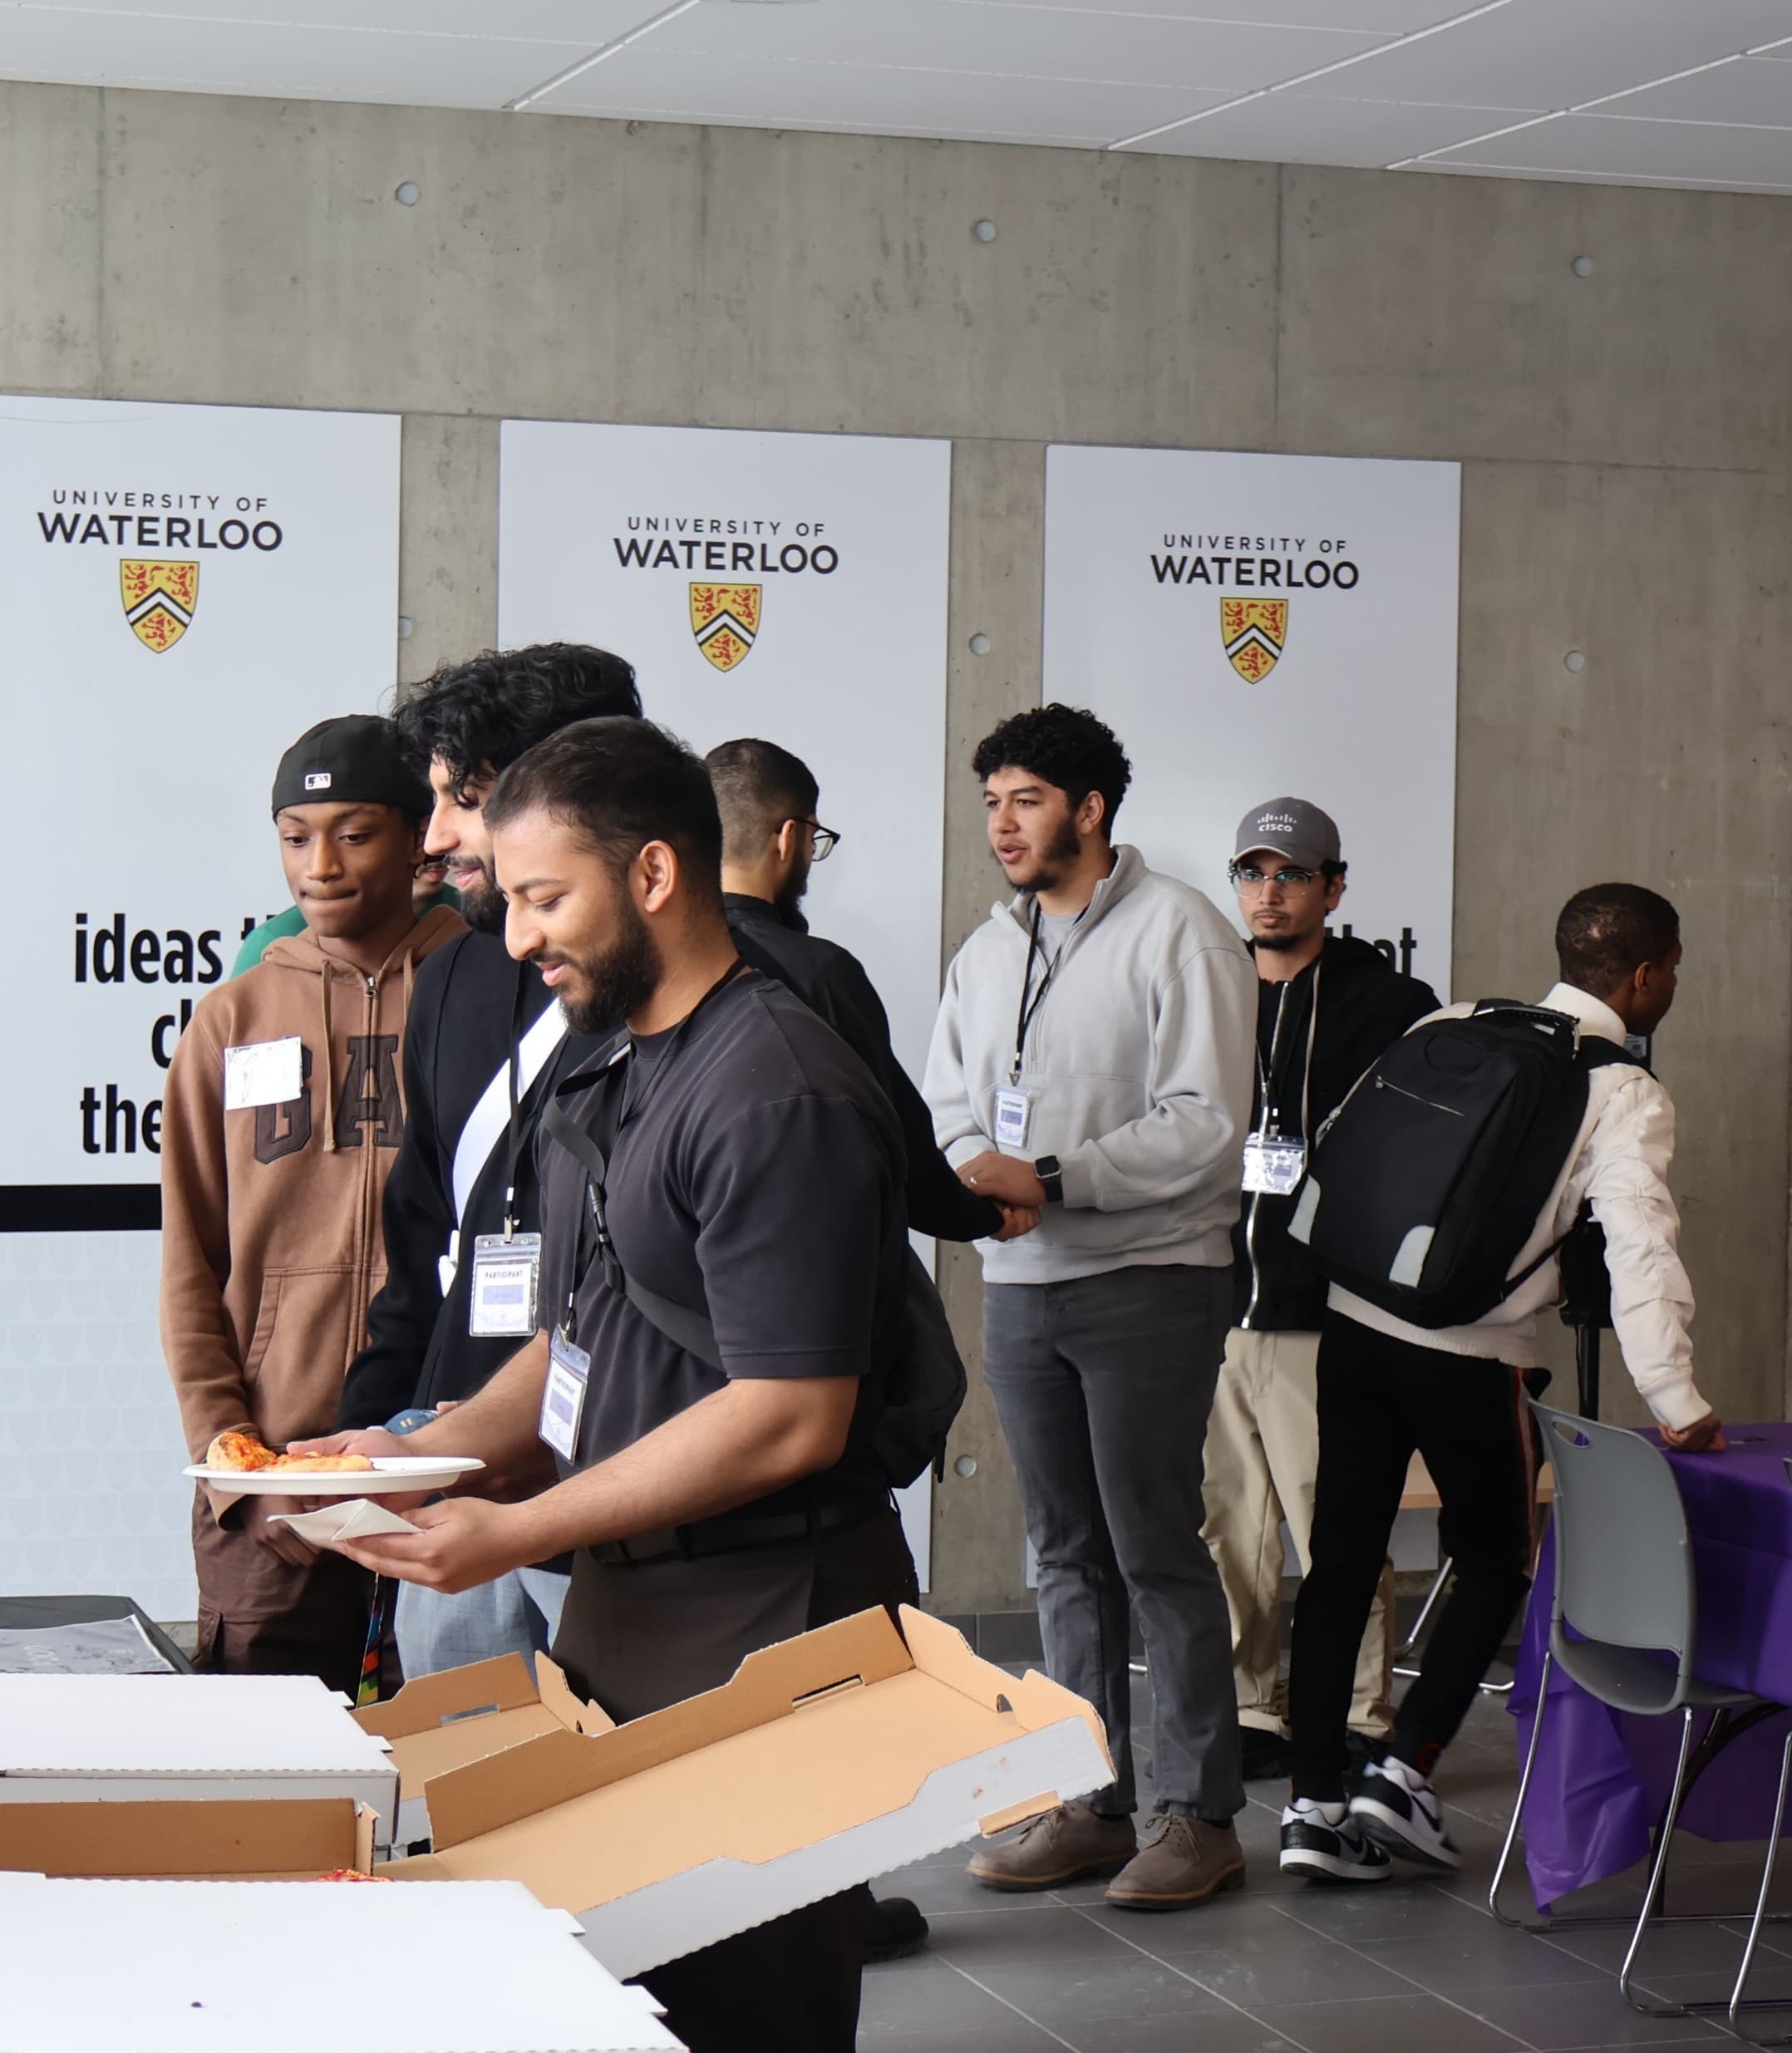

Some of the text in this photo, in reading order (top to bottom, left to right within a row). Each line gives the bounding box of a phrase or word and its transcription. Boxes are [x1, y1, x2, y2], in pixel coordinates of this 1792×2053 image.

[53, 490, 268, 512] UNIVERSITY OF
[37, 511, 283, 552] WATERLOO
[628, 516, 825, 537] UNIVERSITY OF
[1163, 534, 1346, 554] UNIVERSITY OF
[613, 537, 839, 575] WATERLOO
[1150, 554, 1360, 590] WATERLOO
[75, 912, 224, 985] ideas
